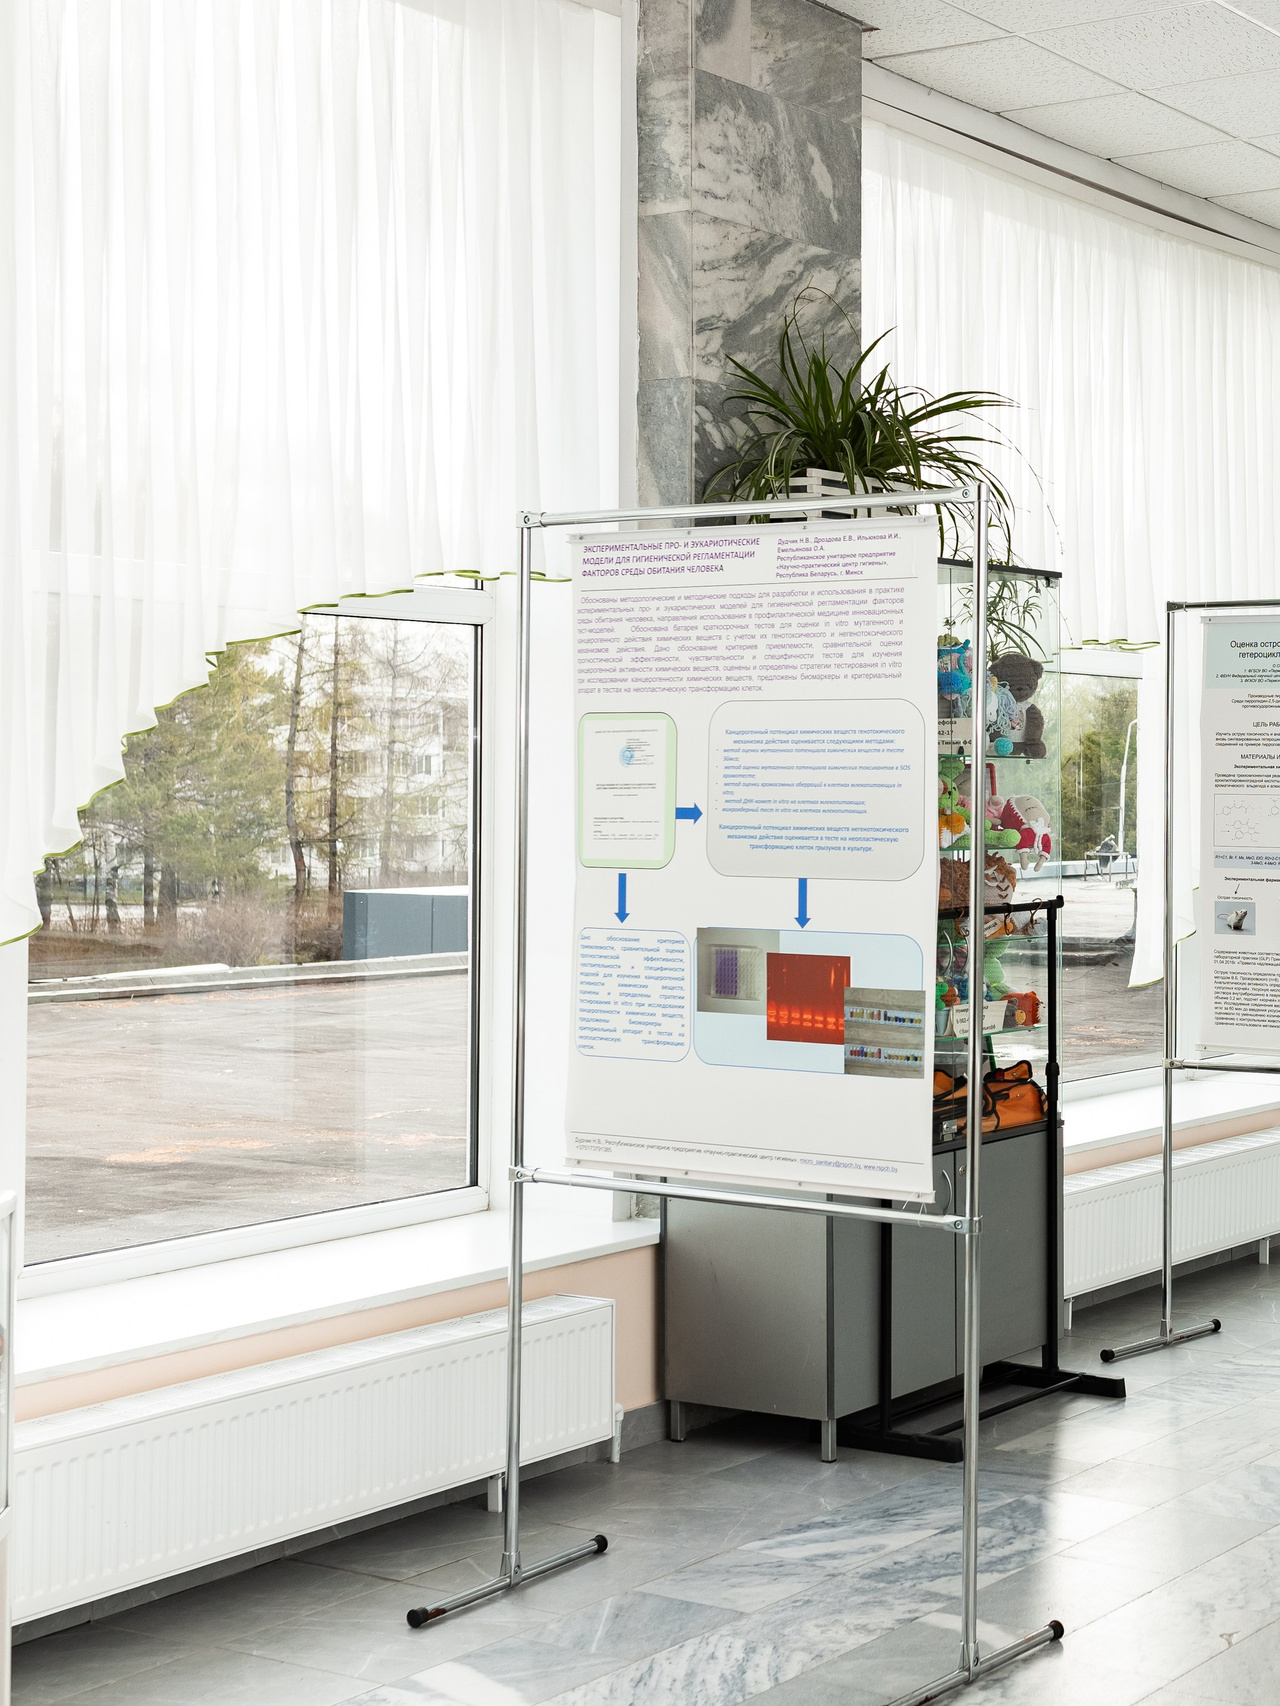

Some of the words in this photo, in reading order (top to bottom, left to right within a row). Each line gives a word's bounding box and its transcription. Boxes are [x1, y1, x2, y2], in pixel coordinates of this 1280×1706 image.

[583, 542, 663, 553] ЭКСПЕРИМЕНТАЛЬНЫЕ
[690, 538, 760, 548] ЭУКАРИОТИЧЕСКИЕ
[582, 557, 614, 566] МОДЕЛИ
[615, 556, 630, 565] ДЛЯ
[632, 552, 691, 563] ГИГИЕНИЧЕСКОЙ
[692, 551, 755, 560] РЕГЛАМЕНТАЦИИ
[582, 568, 620, 577] ФАКТОРОВ
[621, 568, 645, 576] СРЕДЫ
[646, 566, 685, 575] ОБИТАНИЯ
[686, 564, 724, 573] ЧЕЛОВЕКА
[1230, 640, 1258, 649] Оценка
